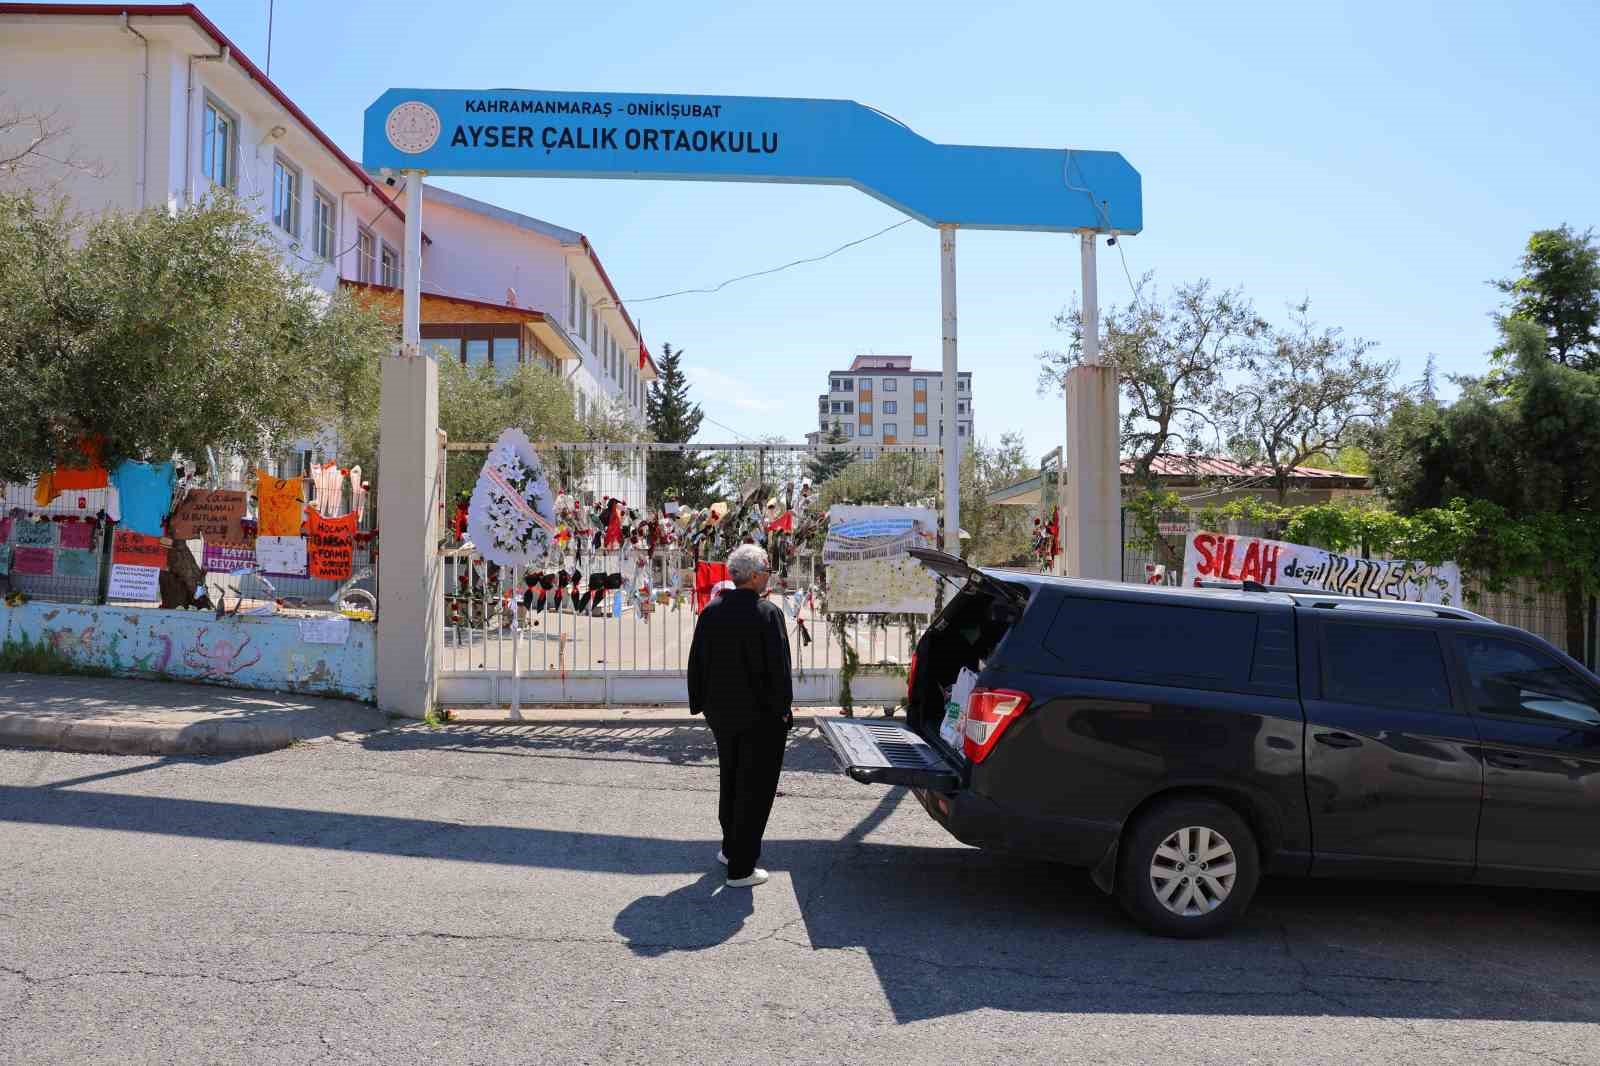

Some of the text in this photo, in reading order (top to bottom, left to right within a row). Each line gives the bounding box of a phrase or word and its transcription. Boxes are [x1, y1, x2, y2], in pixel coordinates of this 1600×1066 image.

[465, 100, 613, 118] KAHRAMANMARAŞ
[627, 100, 722, 119] ONİKİŞUBAT
[450, 125, 778, 155] AYSER ÇALIK ORTAOKULU
[1284, 558, 1326, 585] değil
